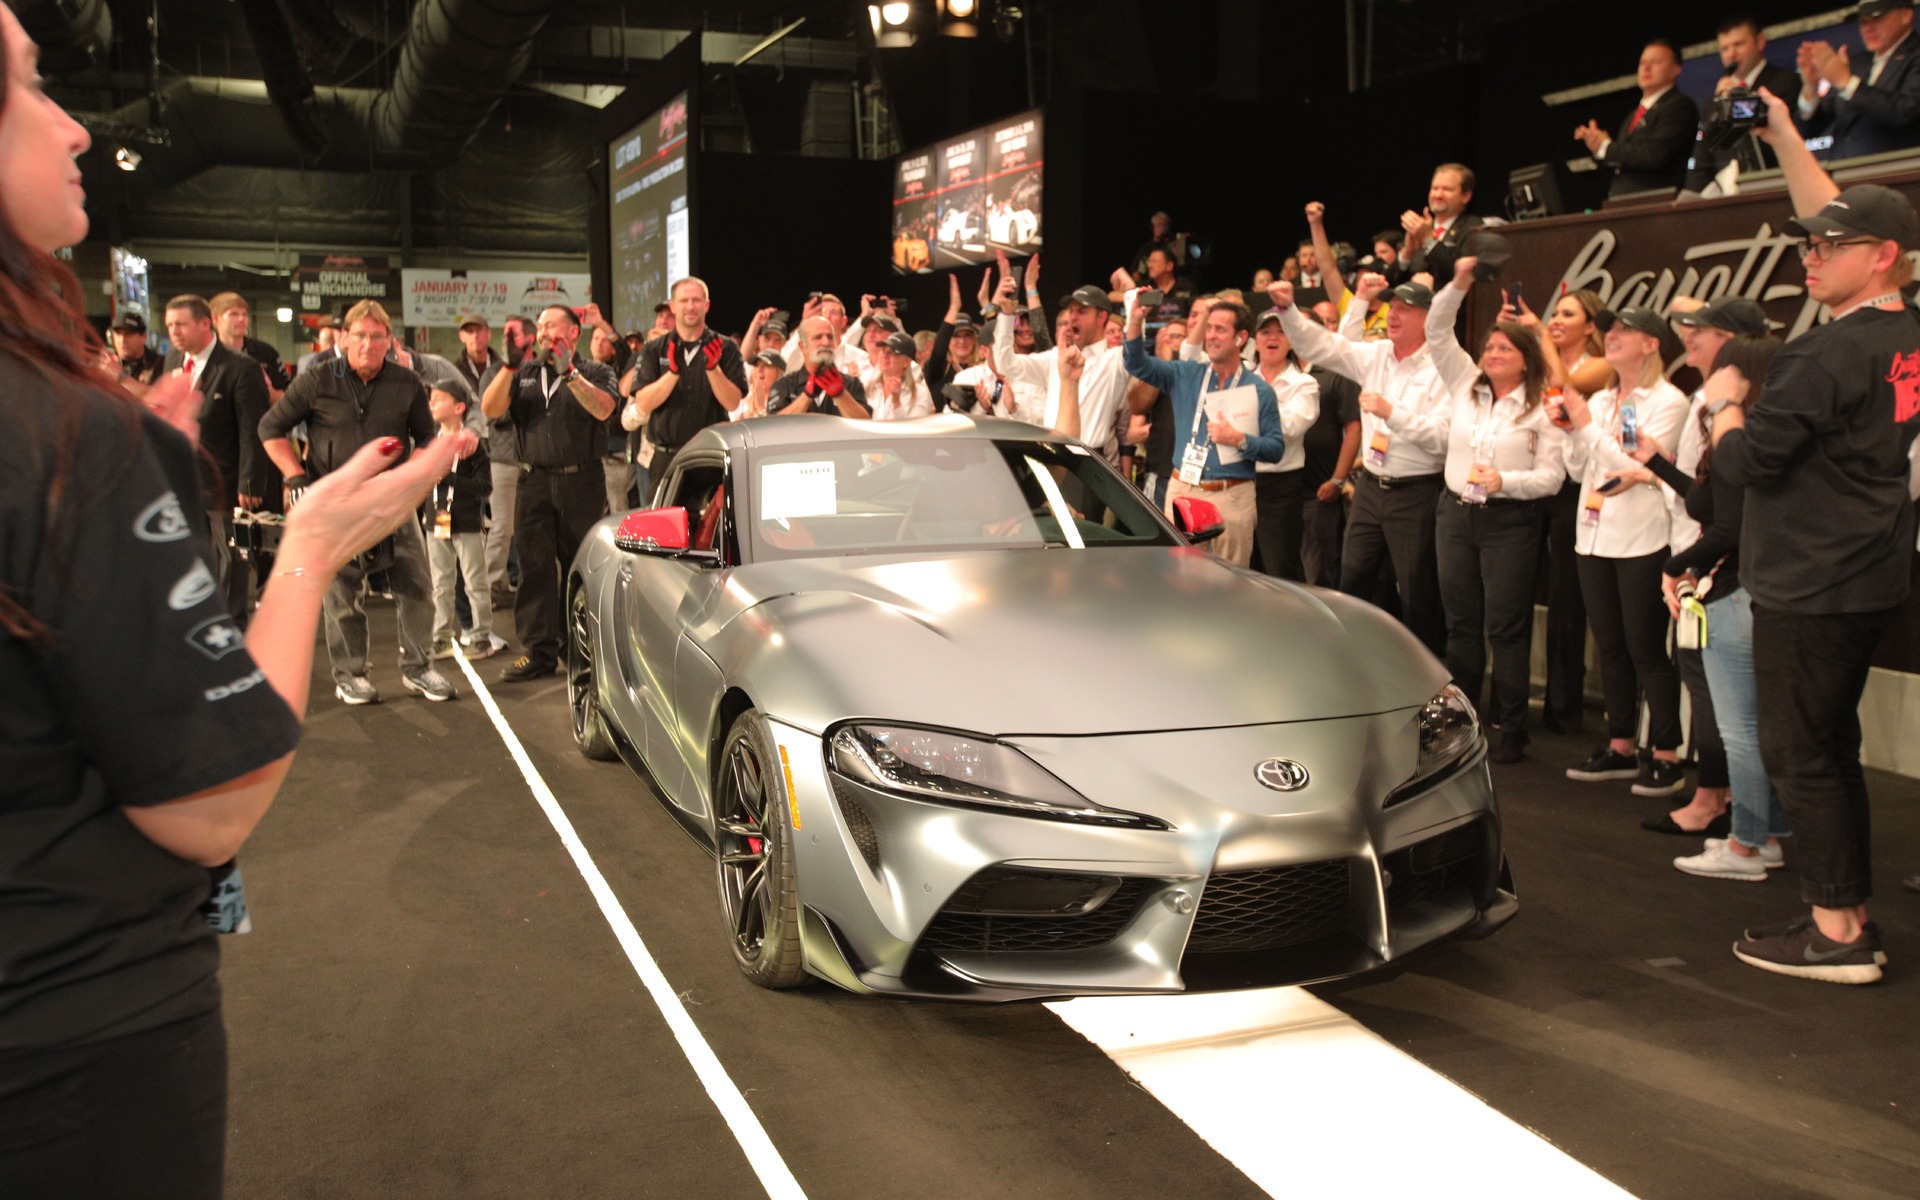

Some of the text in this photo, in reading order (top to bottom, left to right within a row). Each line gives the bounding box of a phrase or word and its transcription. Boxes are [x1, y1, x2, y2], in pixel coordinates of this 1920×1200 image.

[319, 271, 369, 284] OFFICIAL
[303, 281, 386, 297] MERCHANDISE
[411, 281, 507, 294] JANUARY 17-19
[424, 294, 458, 304] NIGHTS
